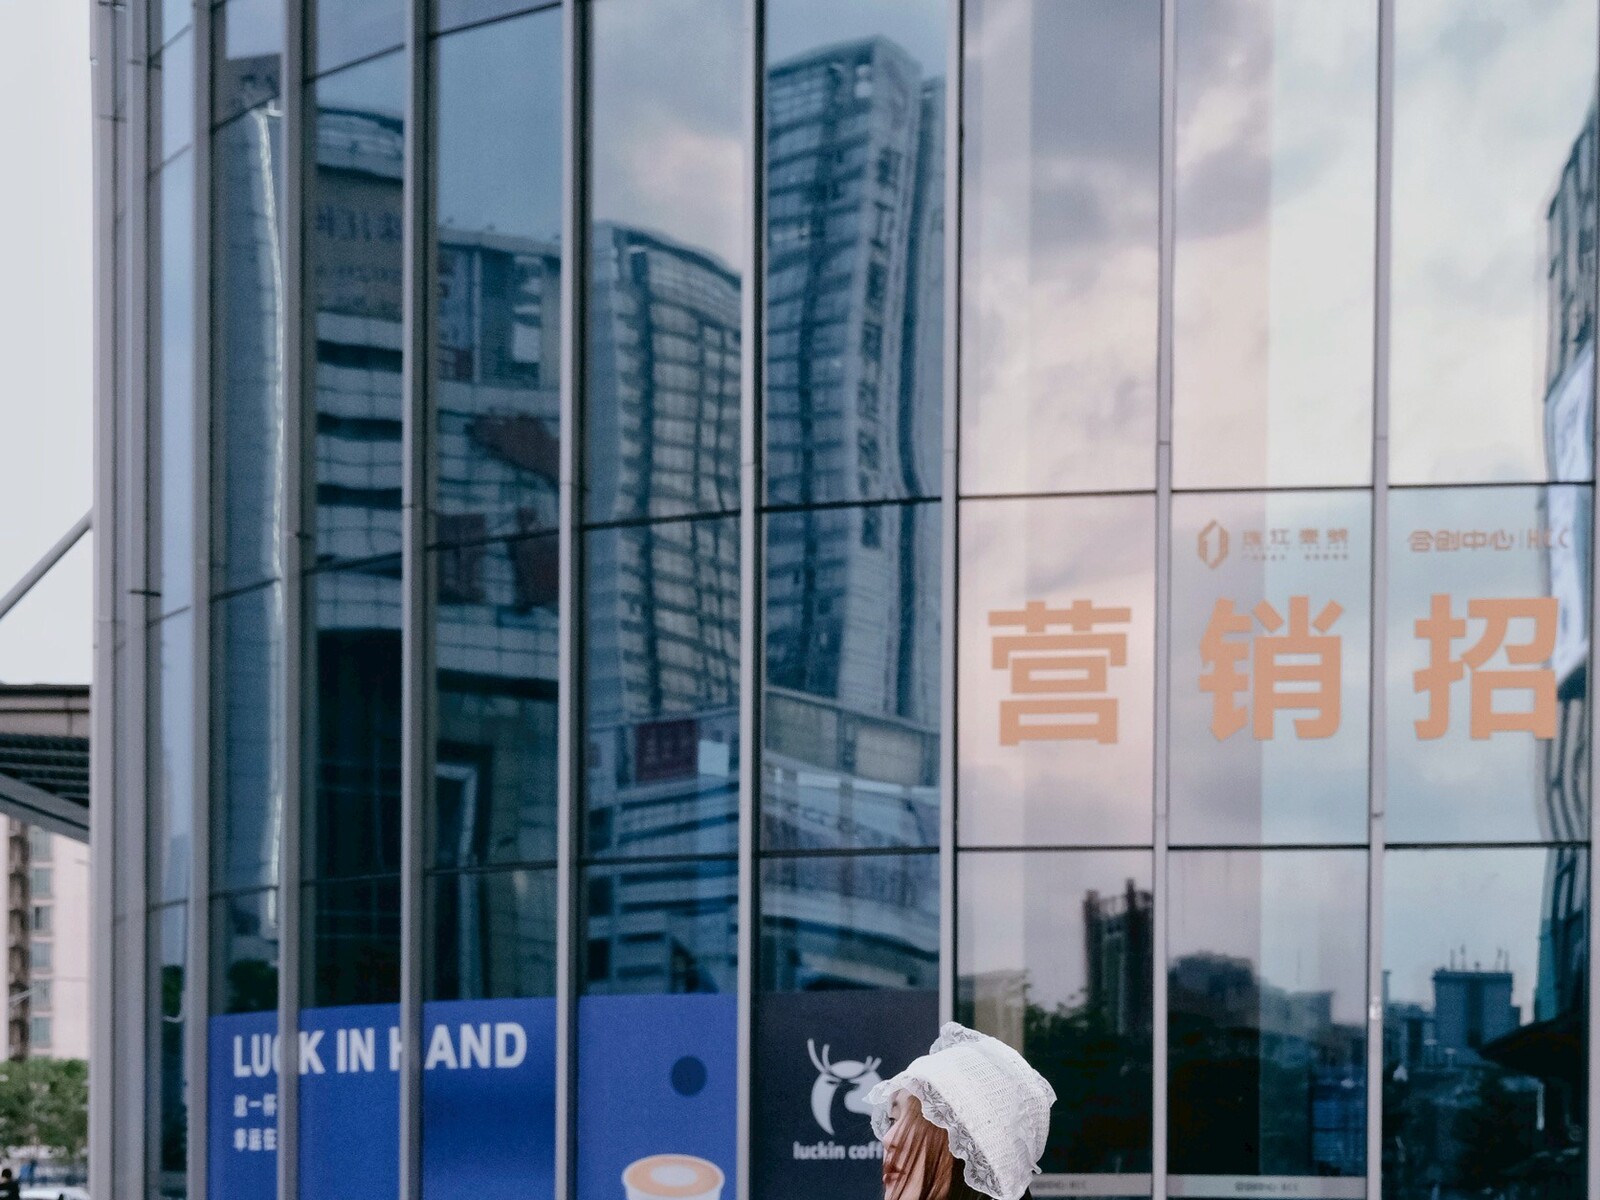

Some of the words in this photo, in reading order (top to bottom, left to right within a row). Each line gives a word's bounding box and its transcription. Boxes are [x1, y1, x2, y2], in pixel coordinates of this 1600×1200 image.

[336, 1027, 375, 1073] IN
[793, 1141, 845, 1160] luckin
[848, 1141, 883, 1160] coff
